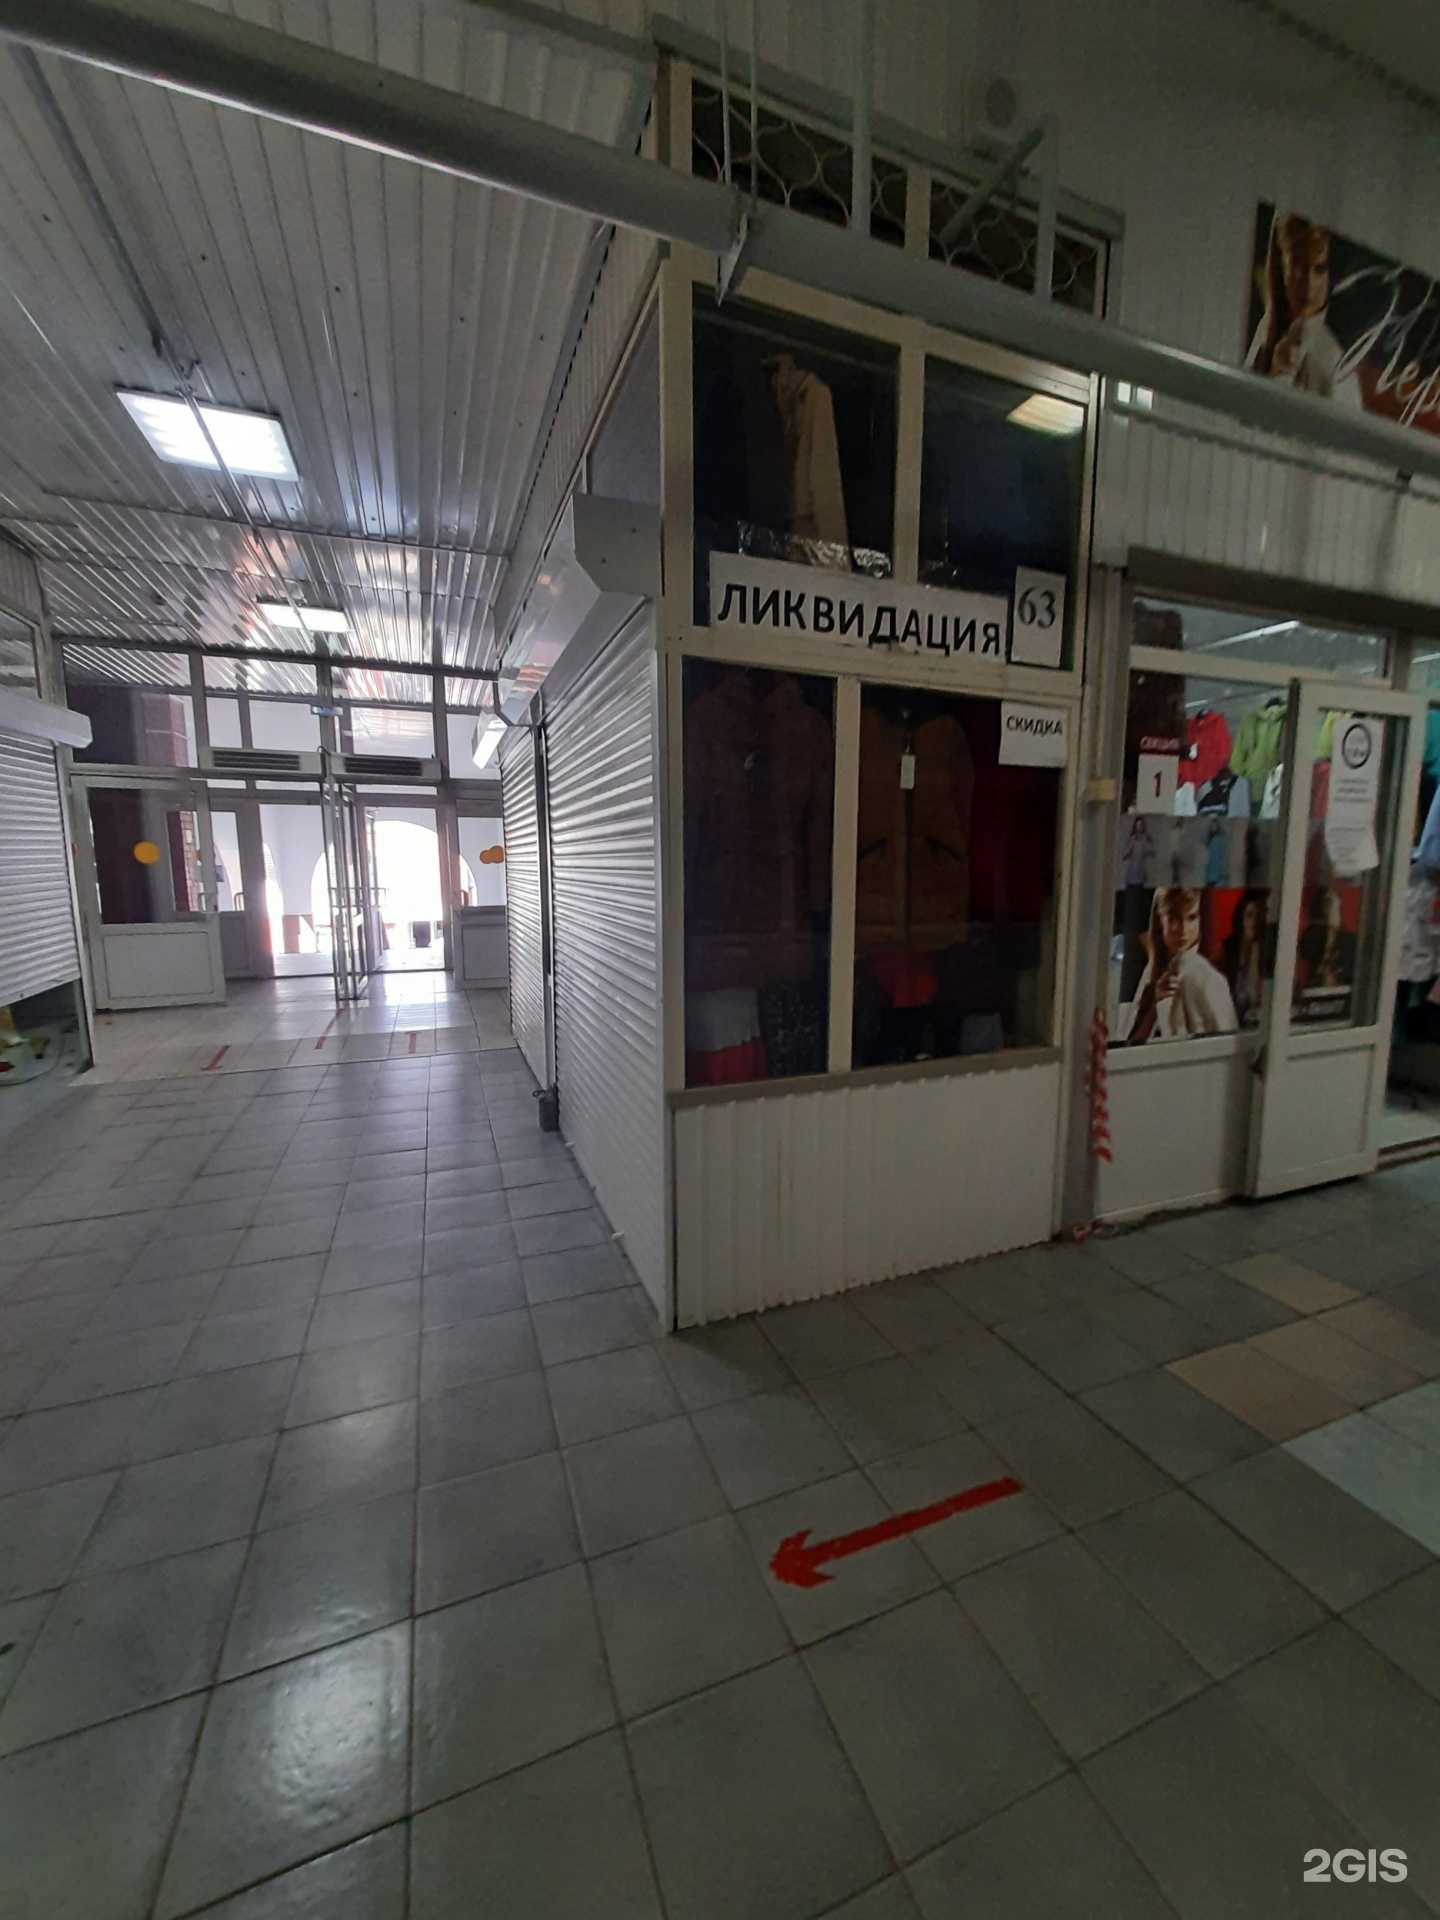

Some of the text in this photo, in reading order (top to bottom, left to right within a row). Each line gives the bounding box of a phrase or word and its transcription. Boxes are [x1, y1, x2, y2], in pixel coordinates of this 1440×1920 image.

[717, 583, 1001, 656] ЛИКВИДАЦИЯ
[1017, 586, 1056, 629] 63
[1006, 715, 1063, 737] СКИДКА
[1154, 770, 1162, 798] 1
